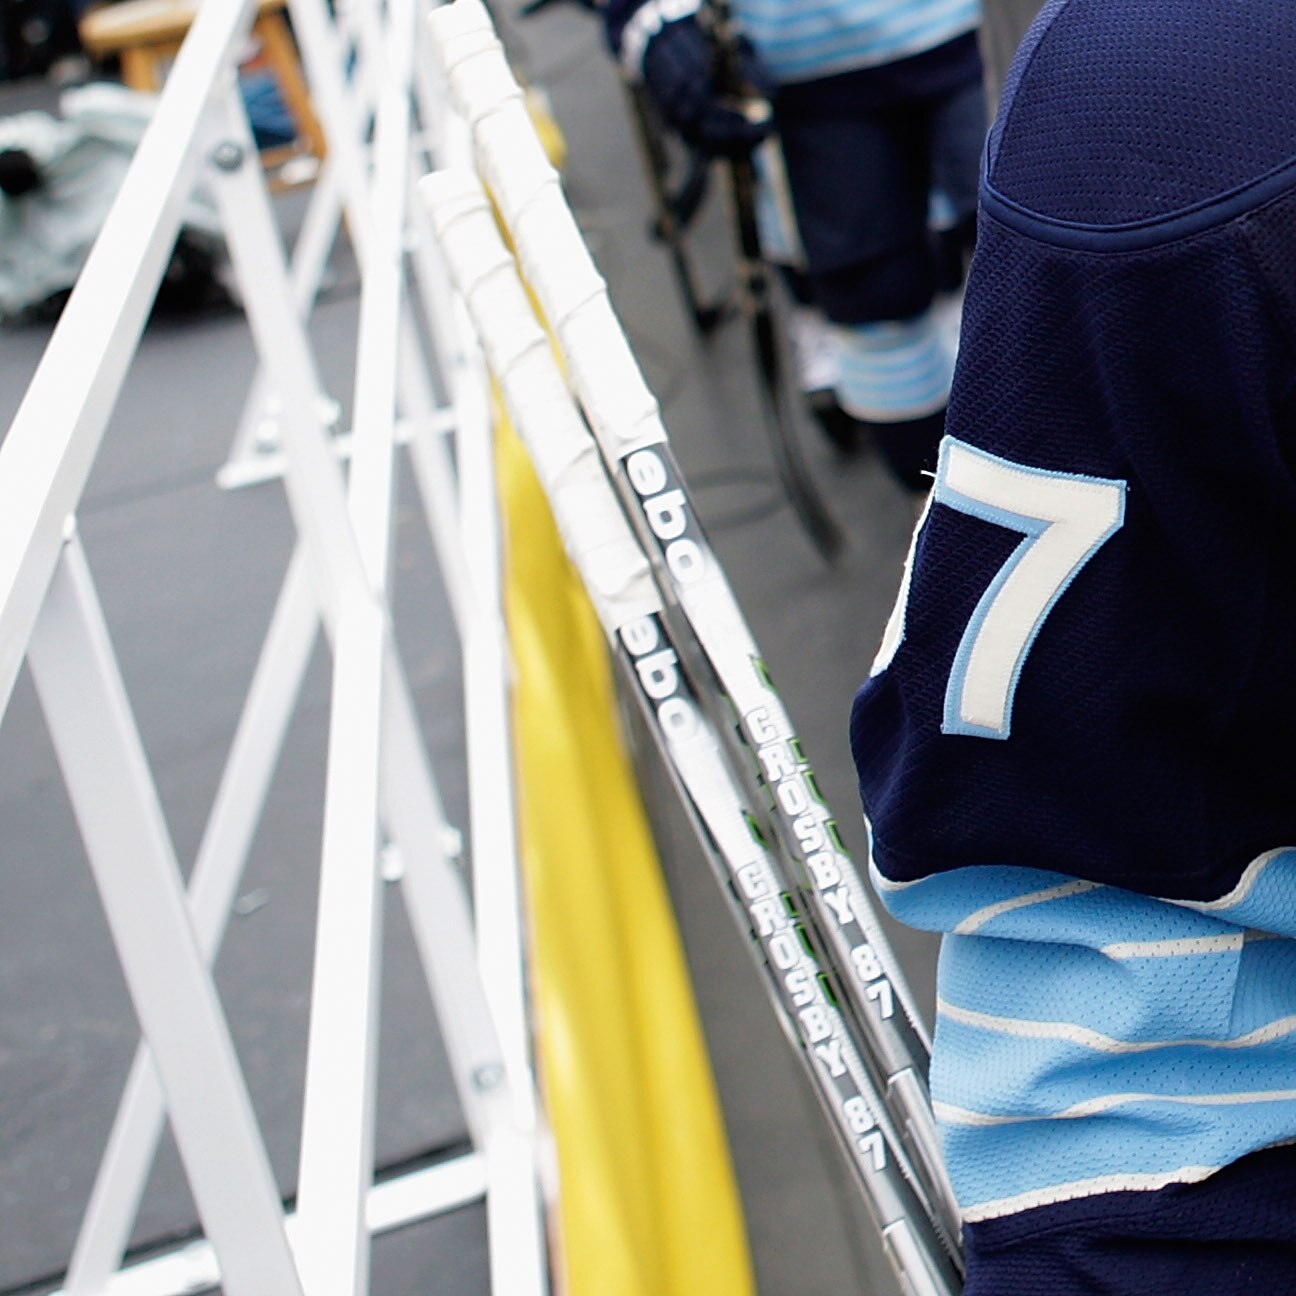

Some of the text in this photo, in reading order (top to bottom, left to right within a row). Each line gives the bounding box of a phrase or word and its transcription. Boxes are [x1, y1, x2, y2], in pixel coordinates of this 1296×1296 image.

[870, 435, 1127, 740] 7
[737, 859, 888, 1171] CROSBY 87
[746, 706, 896, 1020] CROSBY 87
